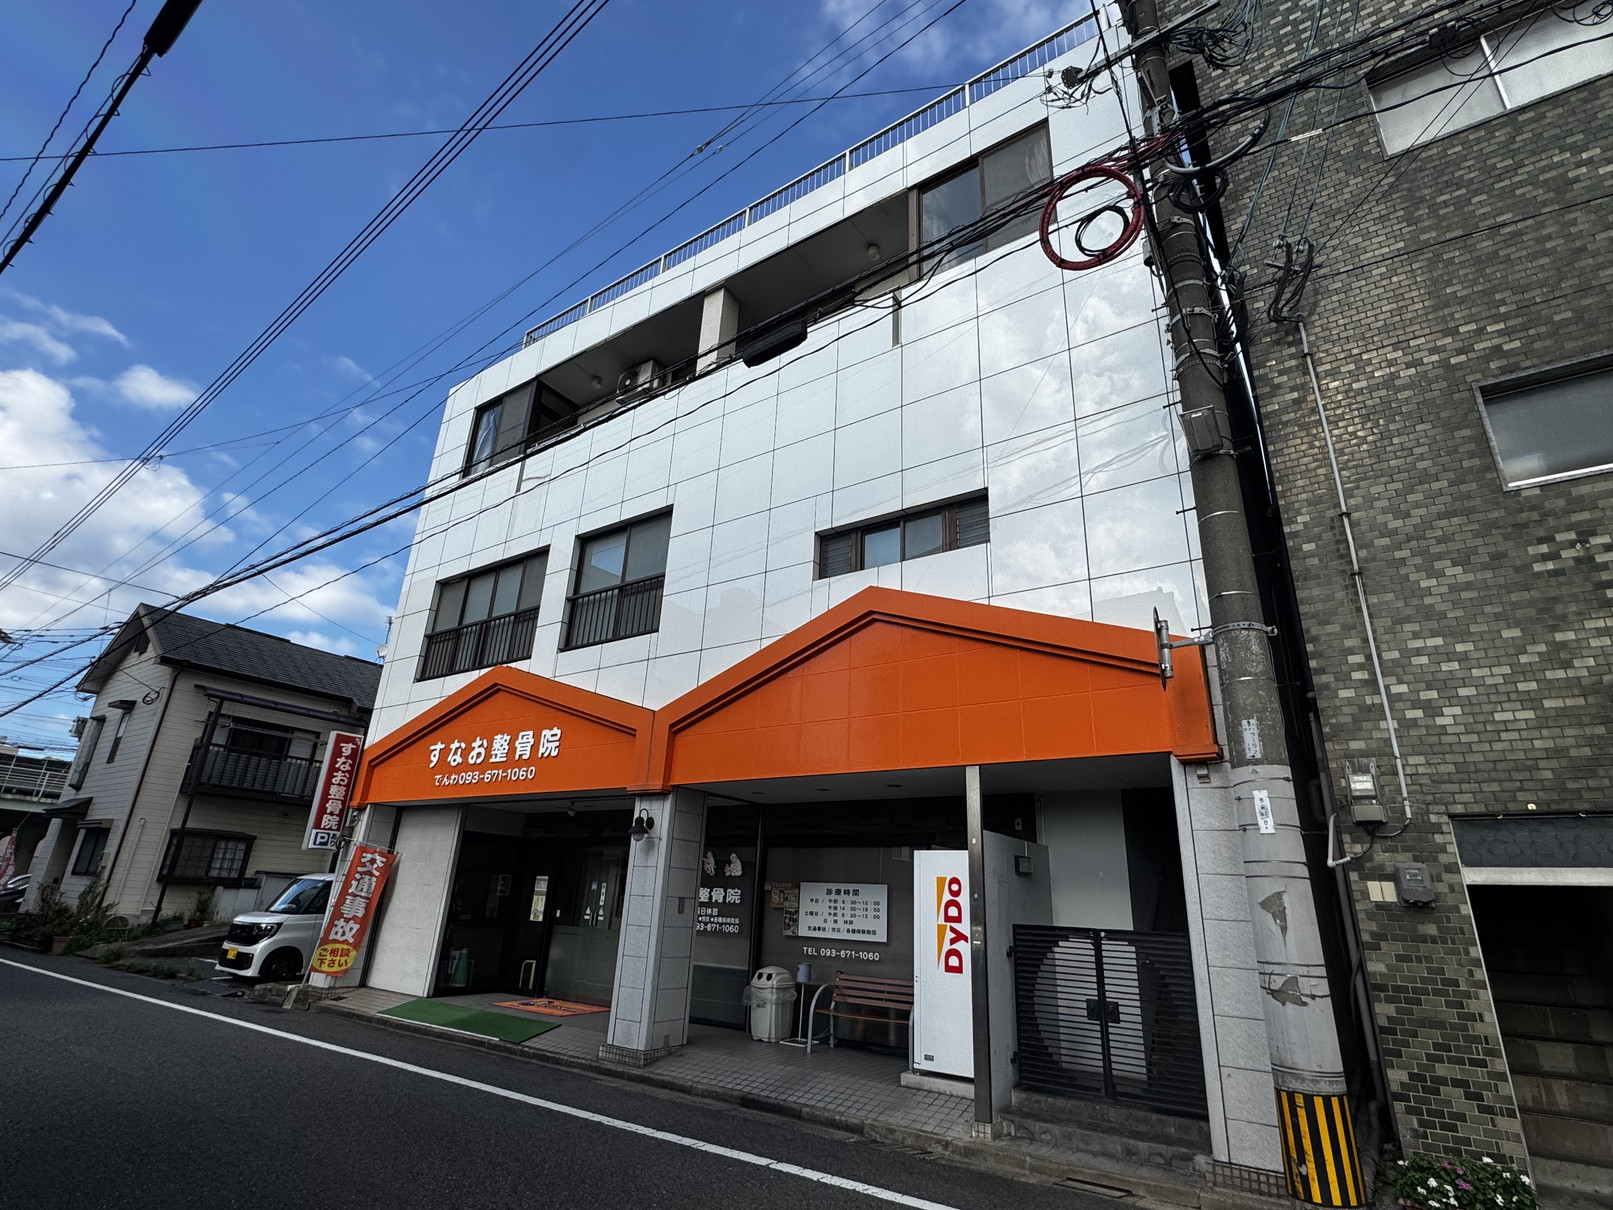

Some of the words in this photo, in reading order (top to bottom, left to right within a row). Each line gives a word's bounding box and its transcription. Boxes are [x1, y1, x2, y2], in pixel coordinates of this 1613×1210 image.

[429, 726, 562, 768] すなお整骨院
[434, 766, 536, 786] でんわ093-671-1060
[320, 742, 357, 830] すなお整骨院
[328, 852, 387, 944] 交通事故
[698, 887, 741, 904] 整骨院
[825, 887, 860, 897] 診療時間
[943, 876, 969, 974] DyDo
[318, 947, 352, 958] ご相談
[802, 946, 818, 956] TEL
[820, 947, 880, 961] 093-671-1060
[317, 957, 348, 968] 下さい
